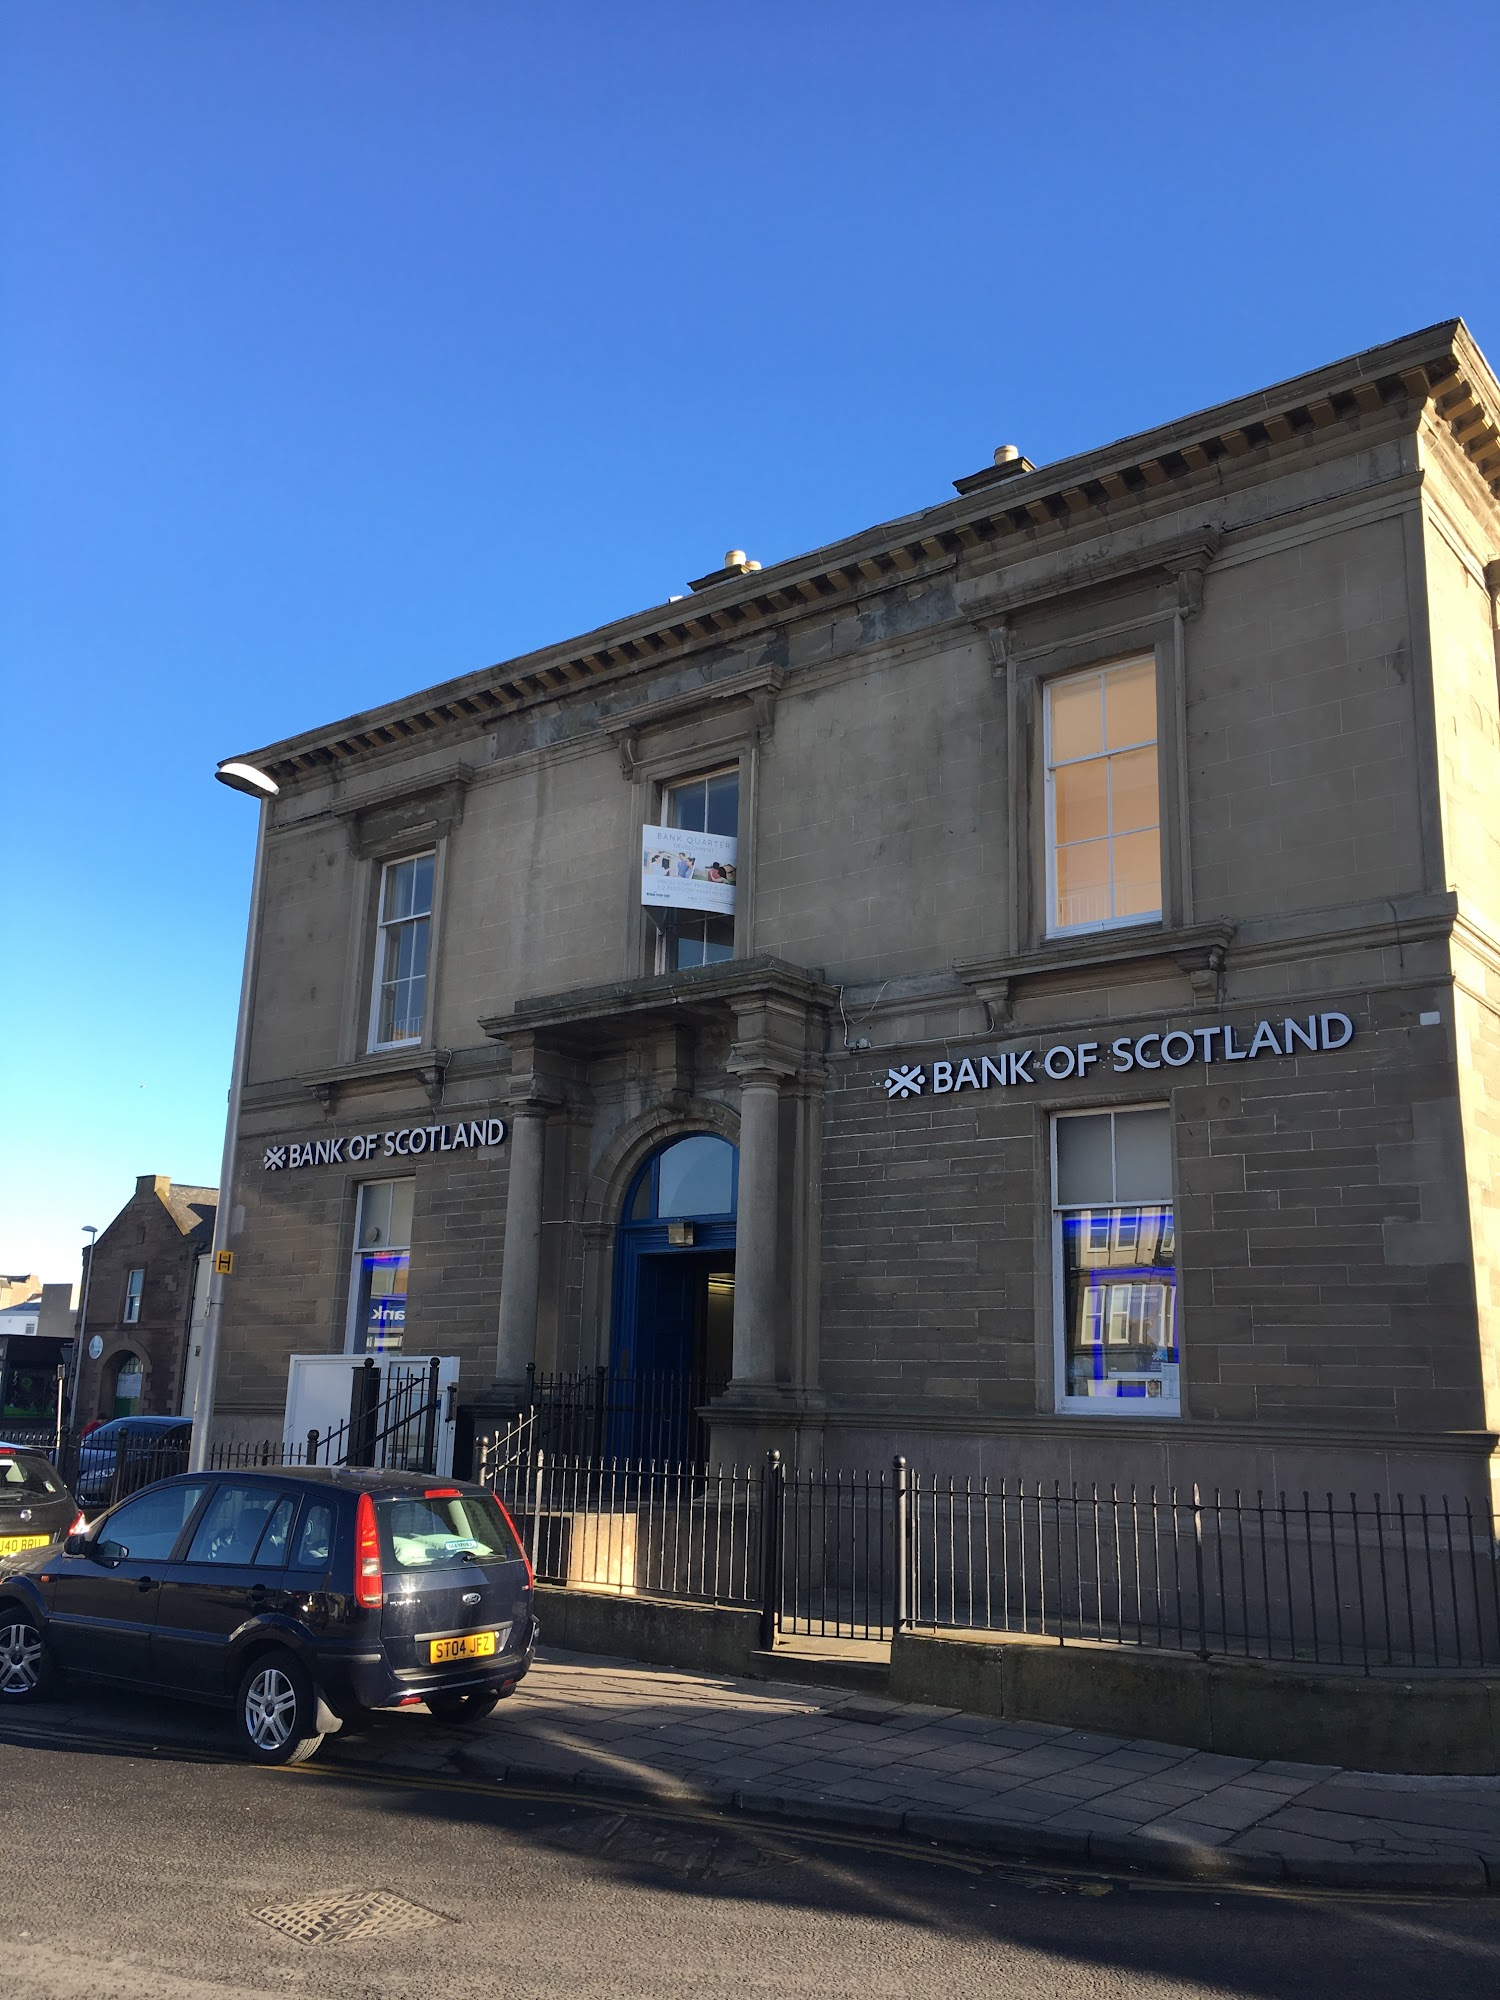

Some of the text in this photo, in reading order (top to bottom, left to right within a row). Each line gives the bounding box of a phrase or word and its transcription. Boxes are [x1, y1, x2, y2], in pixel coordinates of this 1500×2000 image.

[657, 832, 731, 849] BANK QUARTER
[673, 843, 715, 853] DEVELOPMENT
[667, 885, 695, 893] BEDROOM
[933, 1012, 1354, 1094] BANK OF SCOTLAND
[288, 1118, 506, 1169] BANK OF SCOTLAND
[436, 1635, 490, 1658] ST04 JFZ
